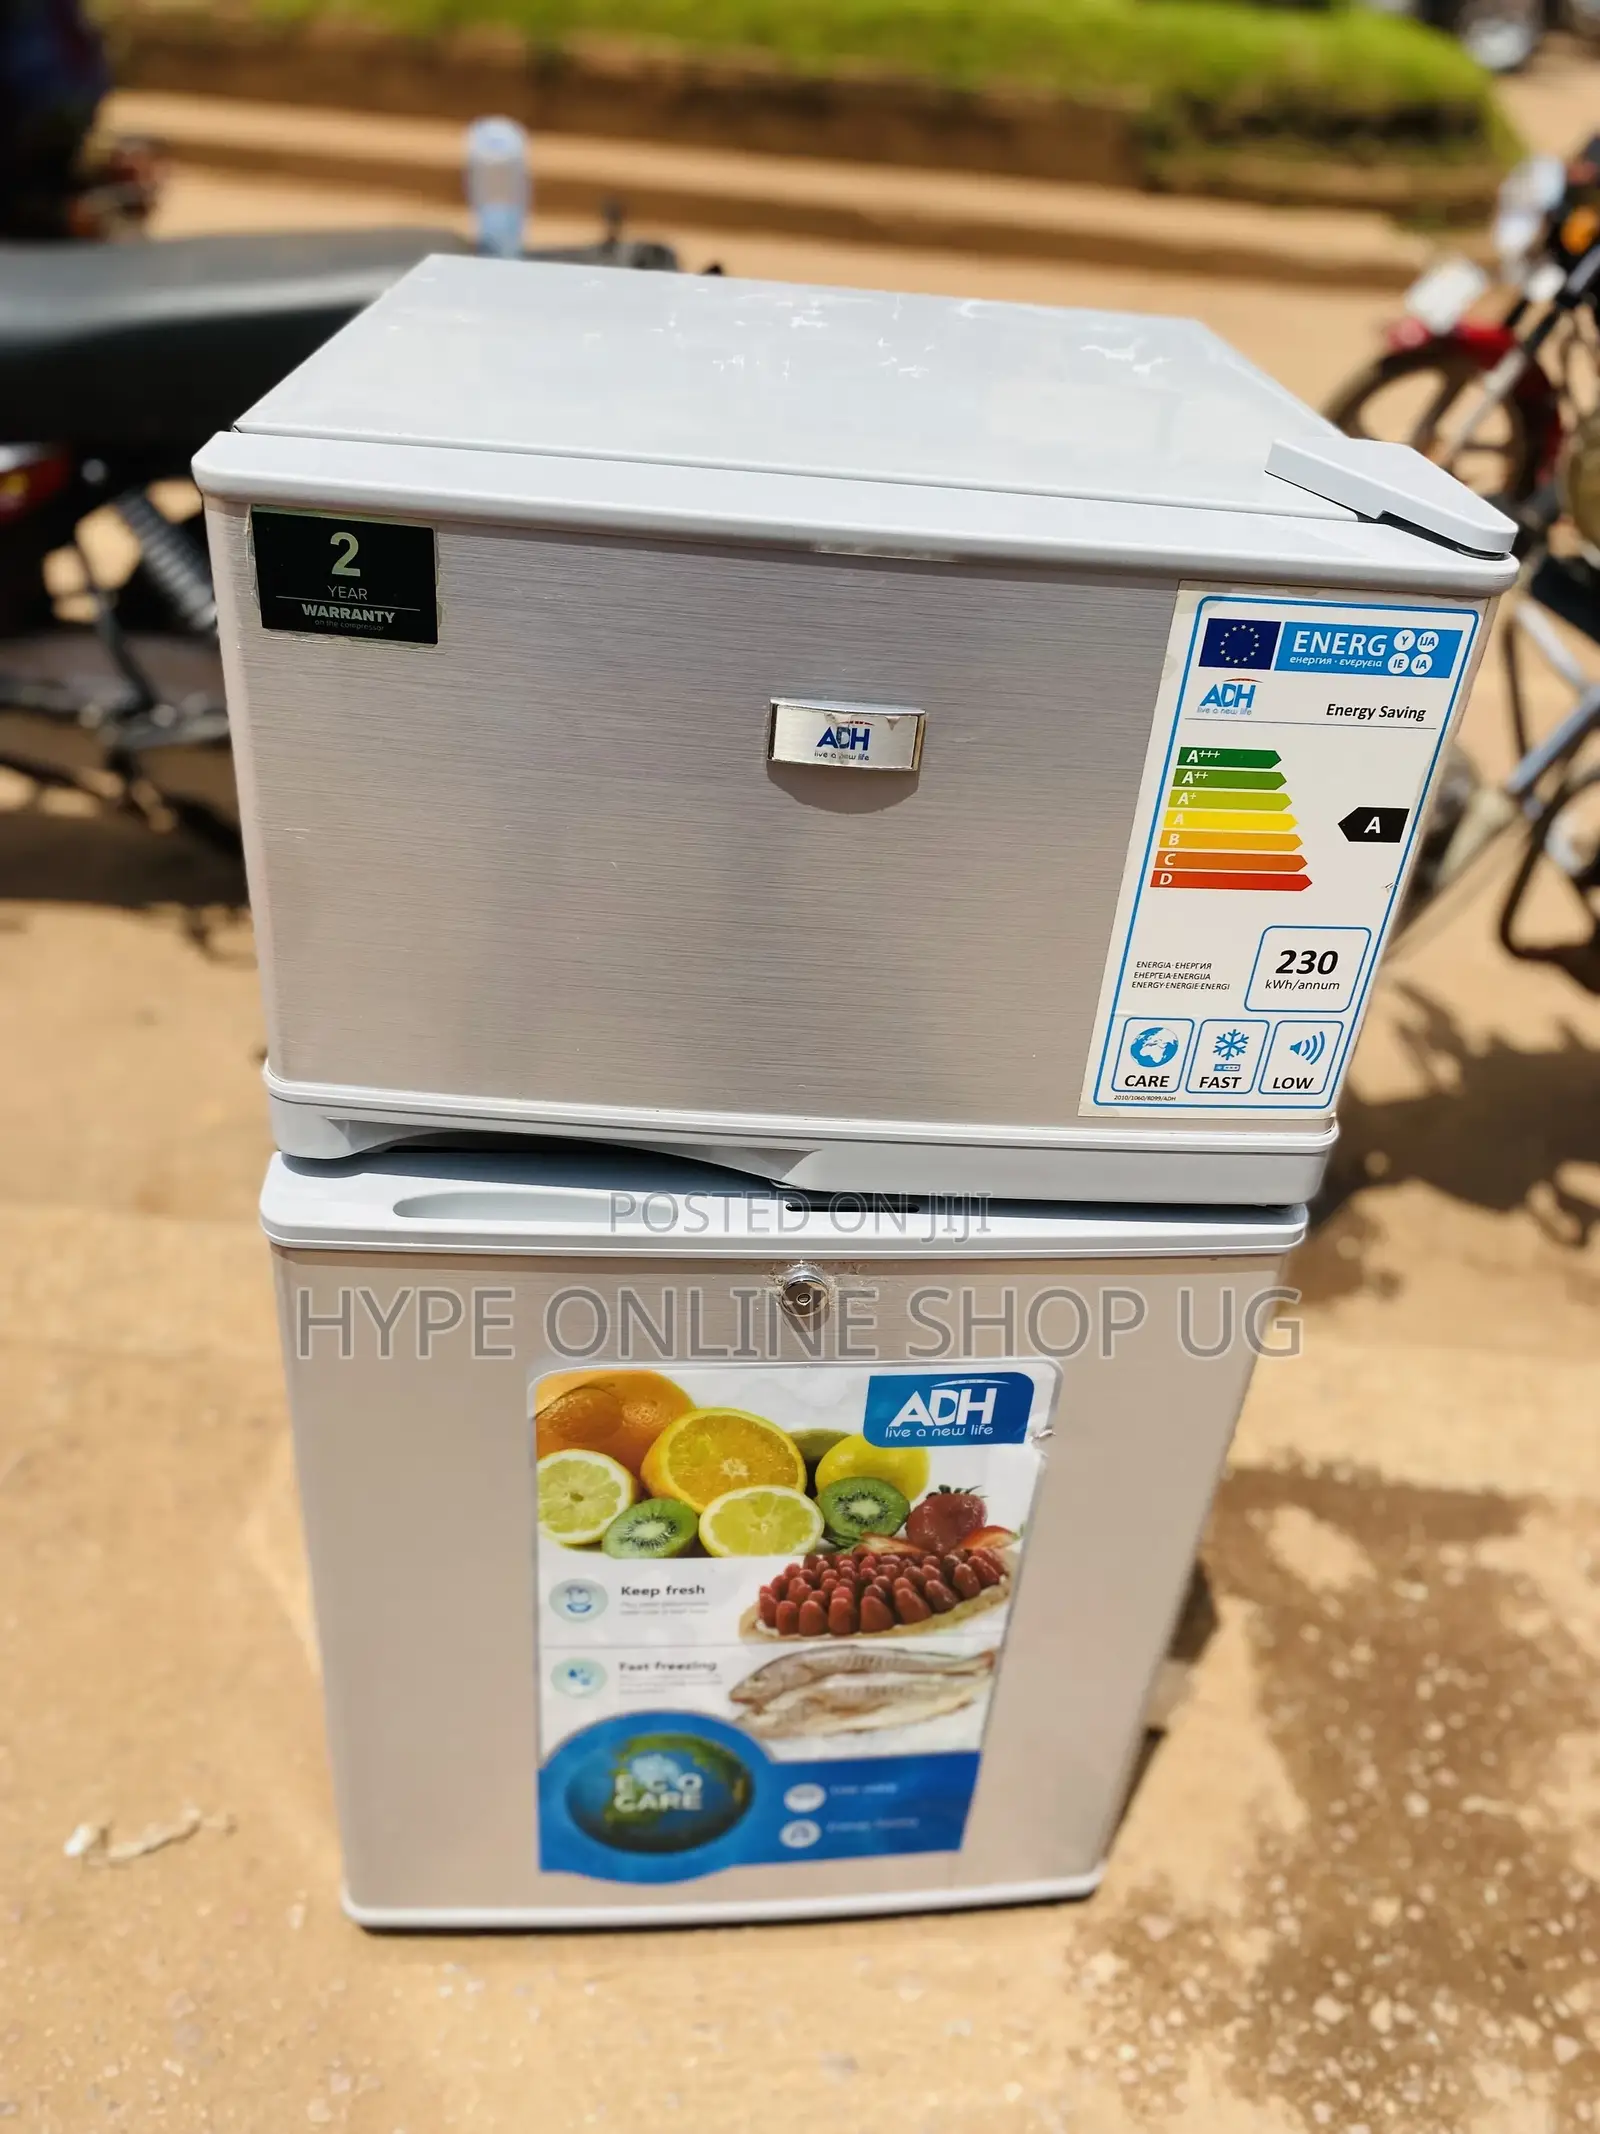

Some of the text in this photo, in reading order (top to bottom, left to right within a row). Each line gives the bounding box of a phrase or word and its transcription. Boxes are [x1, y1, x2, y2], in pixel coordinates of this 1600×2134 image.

[330, 531, 361, 577] 2
[327, 585, 368, 600] YEAR
[301, 603, 396, 624] WARRANTY
[314, 619, 325, 627] on
[1292, 630, 1388, 657] ENERG
[1393, 659, 1427, 670] IE IA
[1199, 683, 1257, 708] ADH
[1220, 708, 1239, 716] new
[1240, 707, 1252, 716] life
[1326, 703, 1426, 722] Energy Saving
[816, 726, 871, 751] ADH
[1186, 749, 1221, 763] A+++
[1181, 771, 1209, 785] A++
[1177, 792, 1197, 805] A+
[1173, 813, 1184, 825] A
[1363, 816, 1381, 834] A
[1168, 833, 1180, 846] B
[1164, 853, 1177, 866] C
[1159, 873, 1173, 885] D
[1275, 949, 1339, 975] 230
[1265, 979, 1340, 991] kWh/annum
[1124, 1074, 1170, 1088] CARE
[1199, 1076, 1242, 1089] FAST
[1272, 1077, 1314, 1089] LOW
[888, 1387, 998, 1427] ADH
[885, 1424, 994, 1438] live a new life
[621, 1585, 705, 1598] Keep fresh
